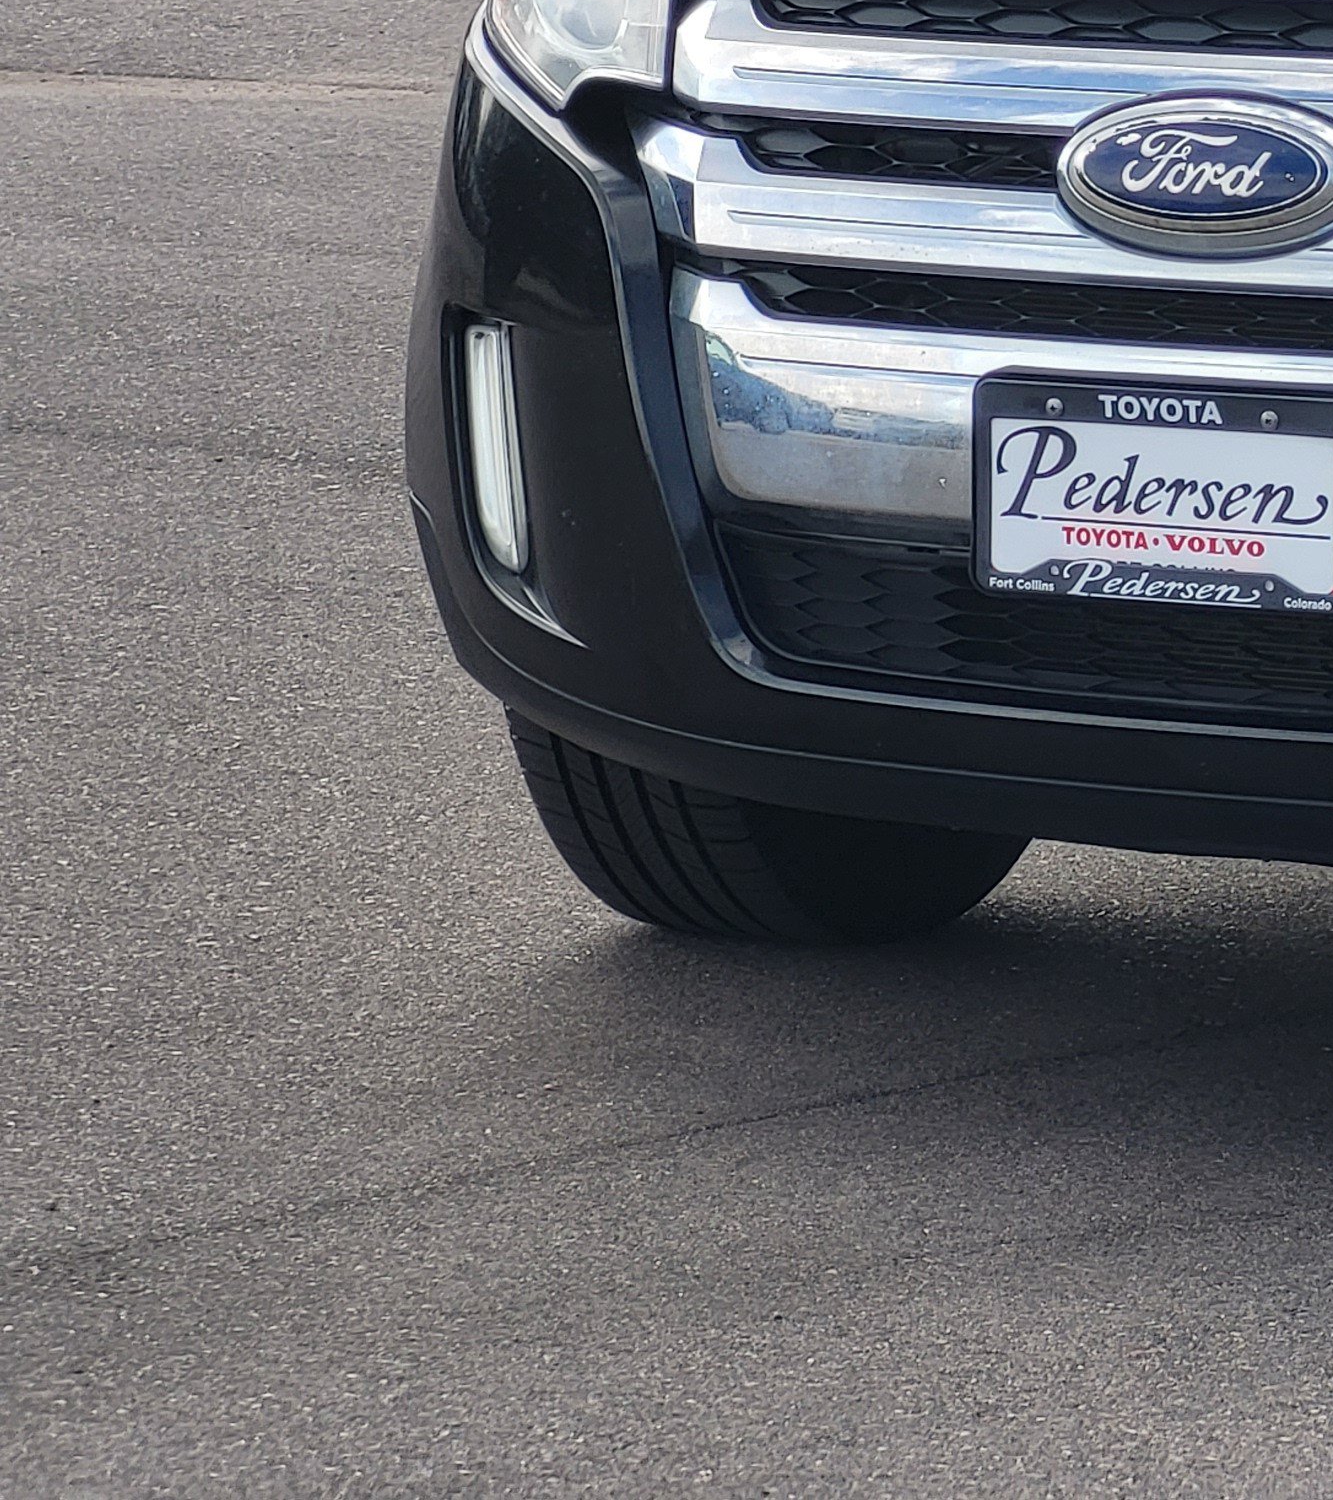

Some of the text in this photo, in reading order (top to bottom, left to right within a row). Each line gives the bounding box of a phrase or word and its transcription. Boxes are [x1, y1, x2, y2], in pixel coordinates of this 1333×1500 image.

[1121, 128, 1272, 198] Ford
[1098, 394, 1223, 425] TOYOTA
[996, 425, 1329, 526] Pedersen
[1062, 526, 1265, 557] TOYOTA VOLVO
[989, 576, 1055, 592] Fort Collins
[1062, 559, 1261, 603] Pedersen
[1283, 596, 1332, 612] Colorado
